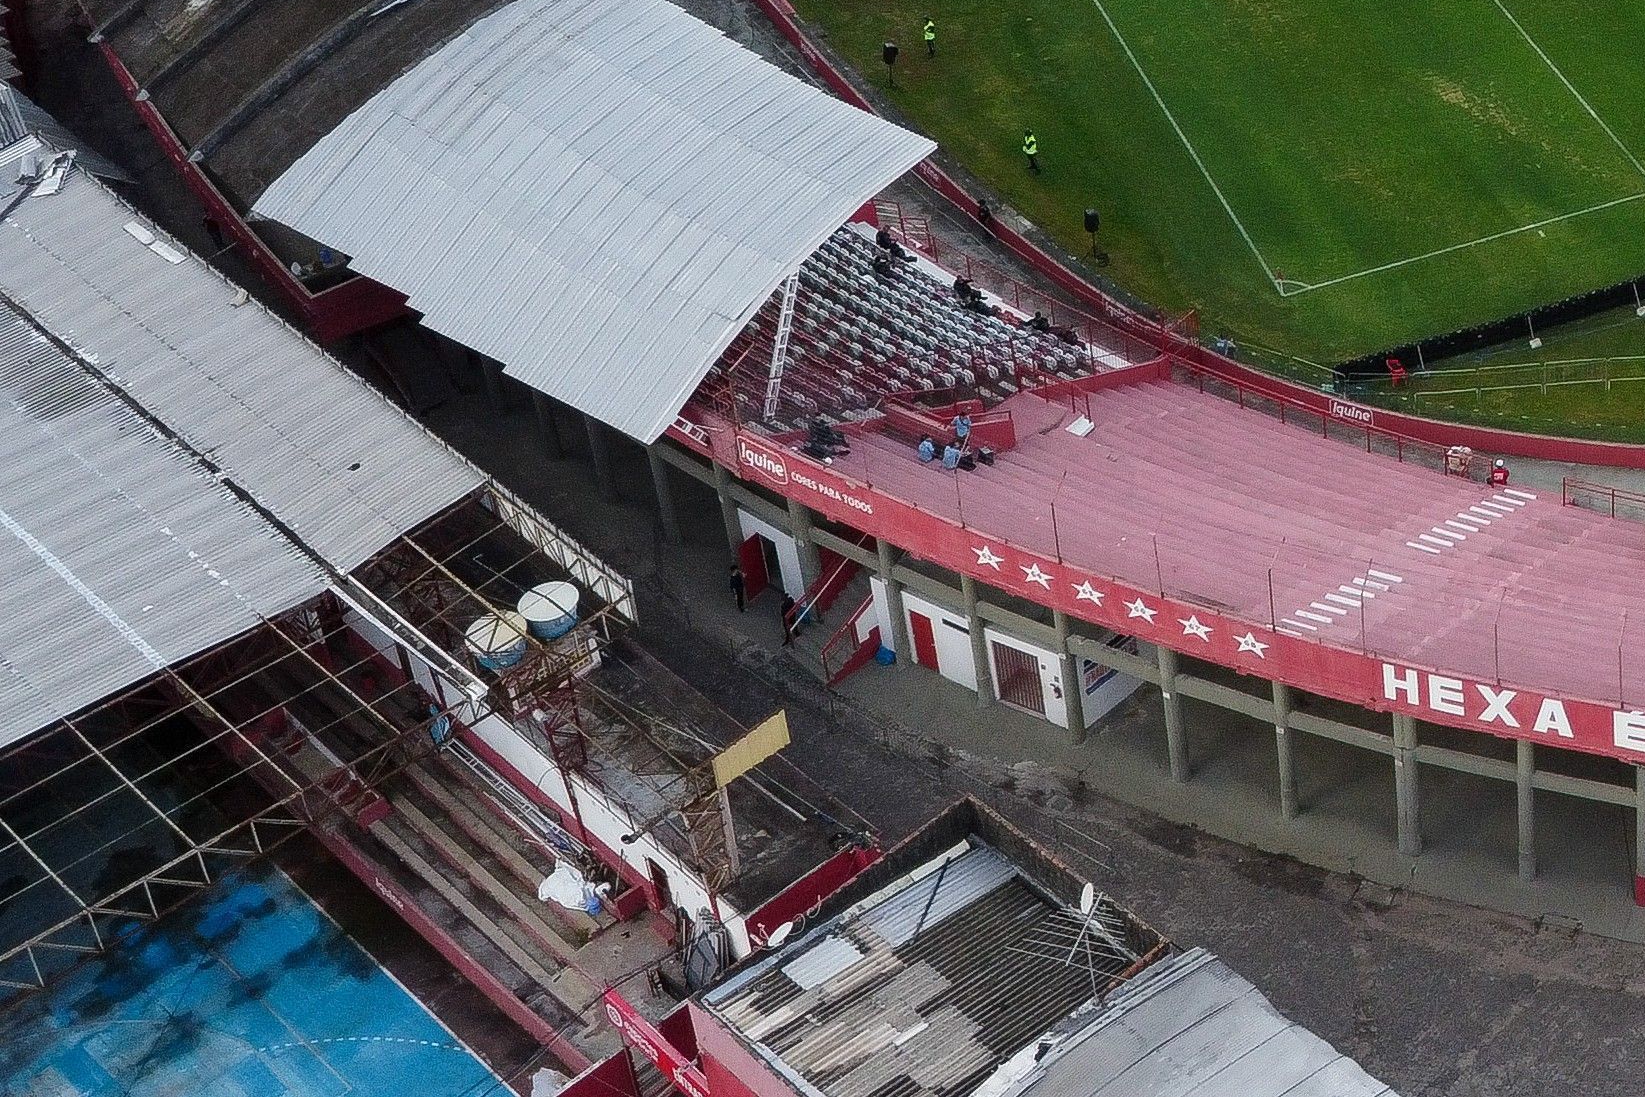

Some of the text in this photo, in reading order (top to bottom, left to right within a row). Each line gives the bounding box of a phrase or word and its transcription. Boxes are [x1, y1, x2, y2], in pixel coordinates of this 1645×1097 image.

[1333, 402, 1371, 421] Iquine
[741, 442, 873, 515] Iquine CORES PARA TODOS
[1382, 663, 1574, 739] HEXA
